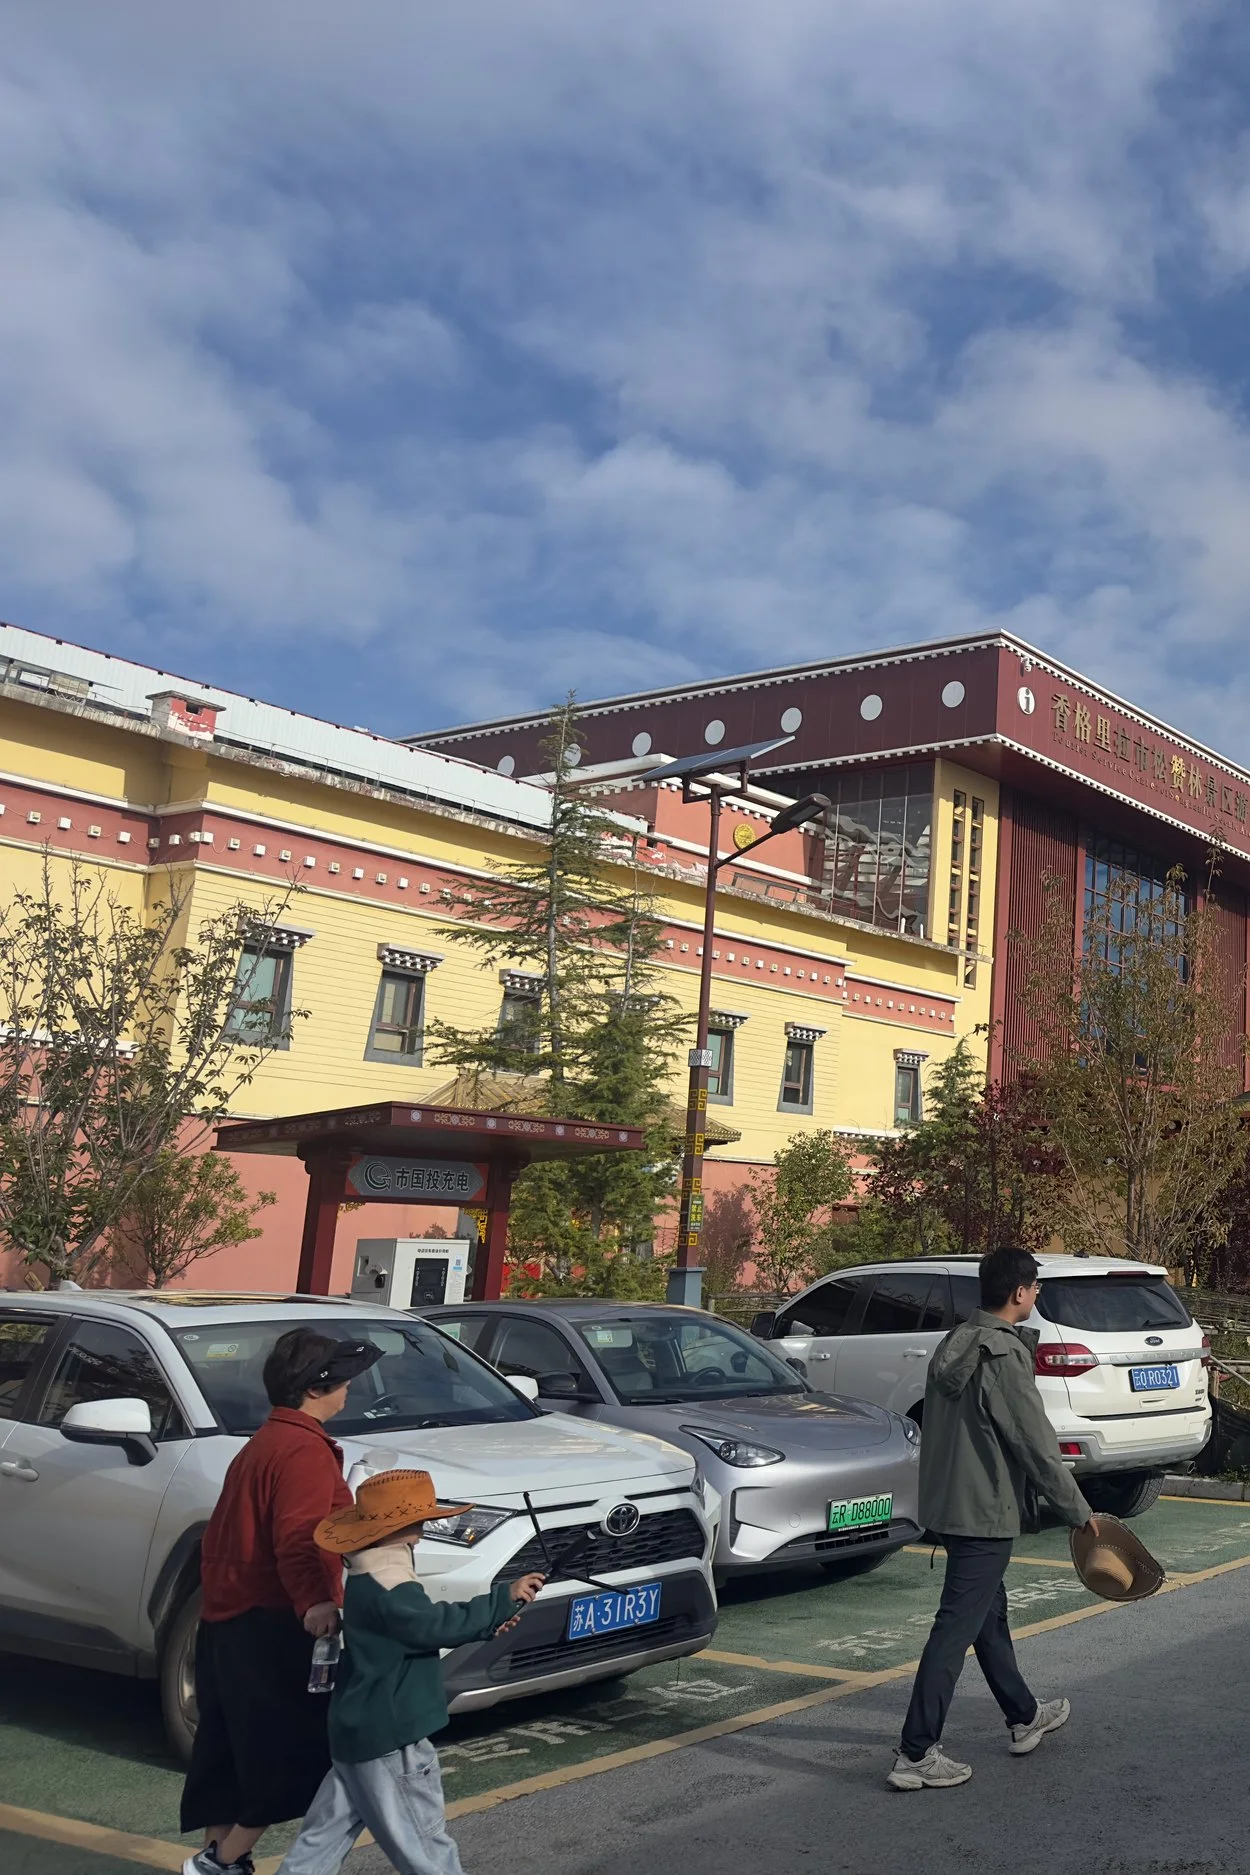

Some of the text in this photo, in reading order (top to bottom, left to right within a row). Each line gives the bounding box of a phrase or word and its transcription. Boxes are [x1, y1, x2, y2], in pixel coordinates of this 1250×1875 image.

[1092, 751, 1127, 775] Service
[395, 1166, 470, 1193] 市国投充电
